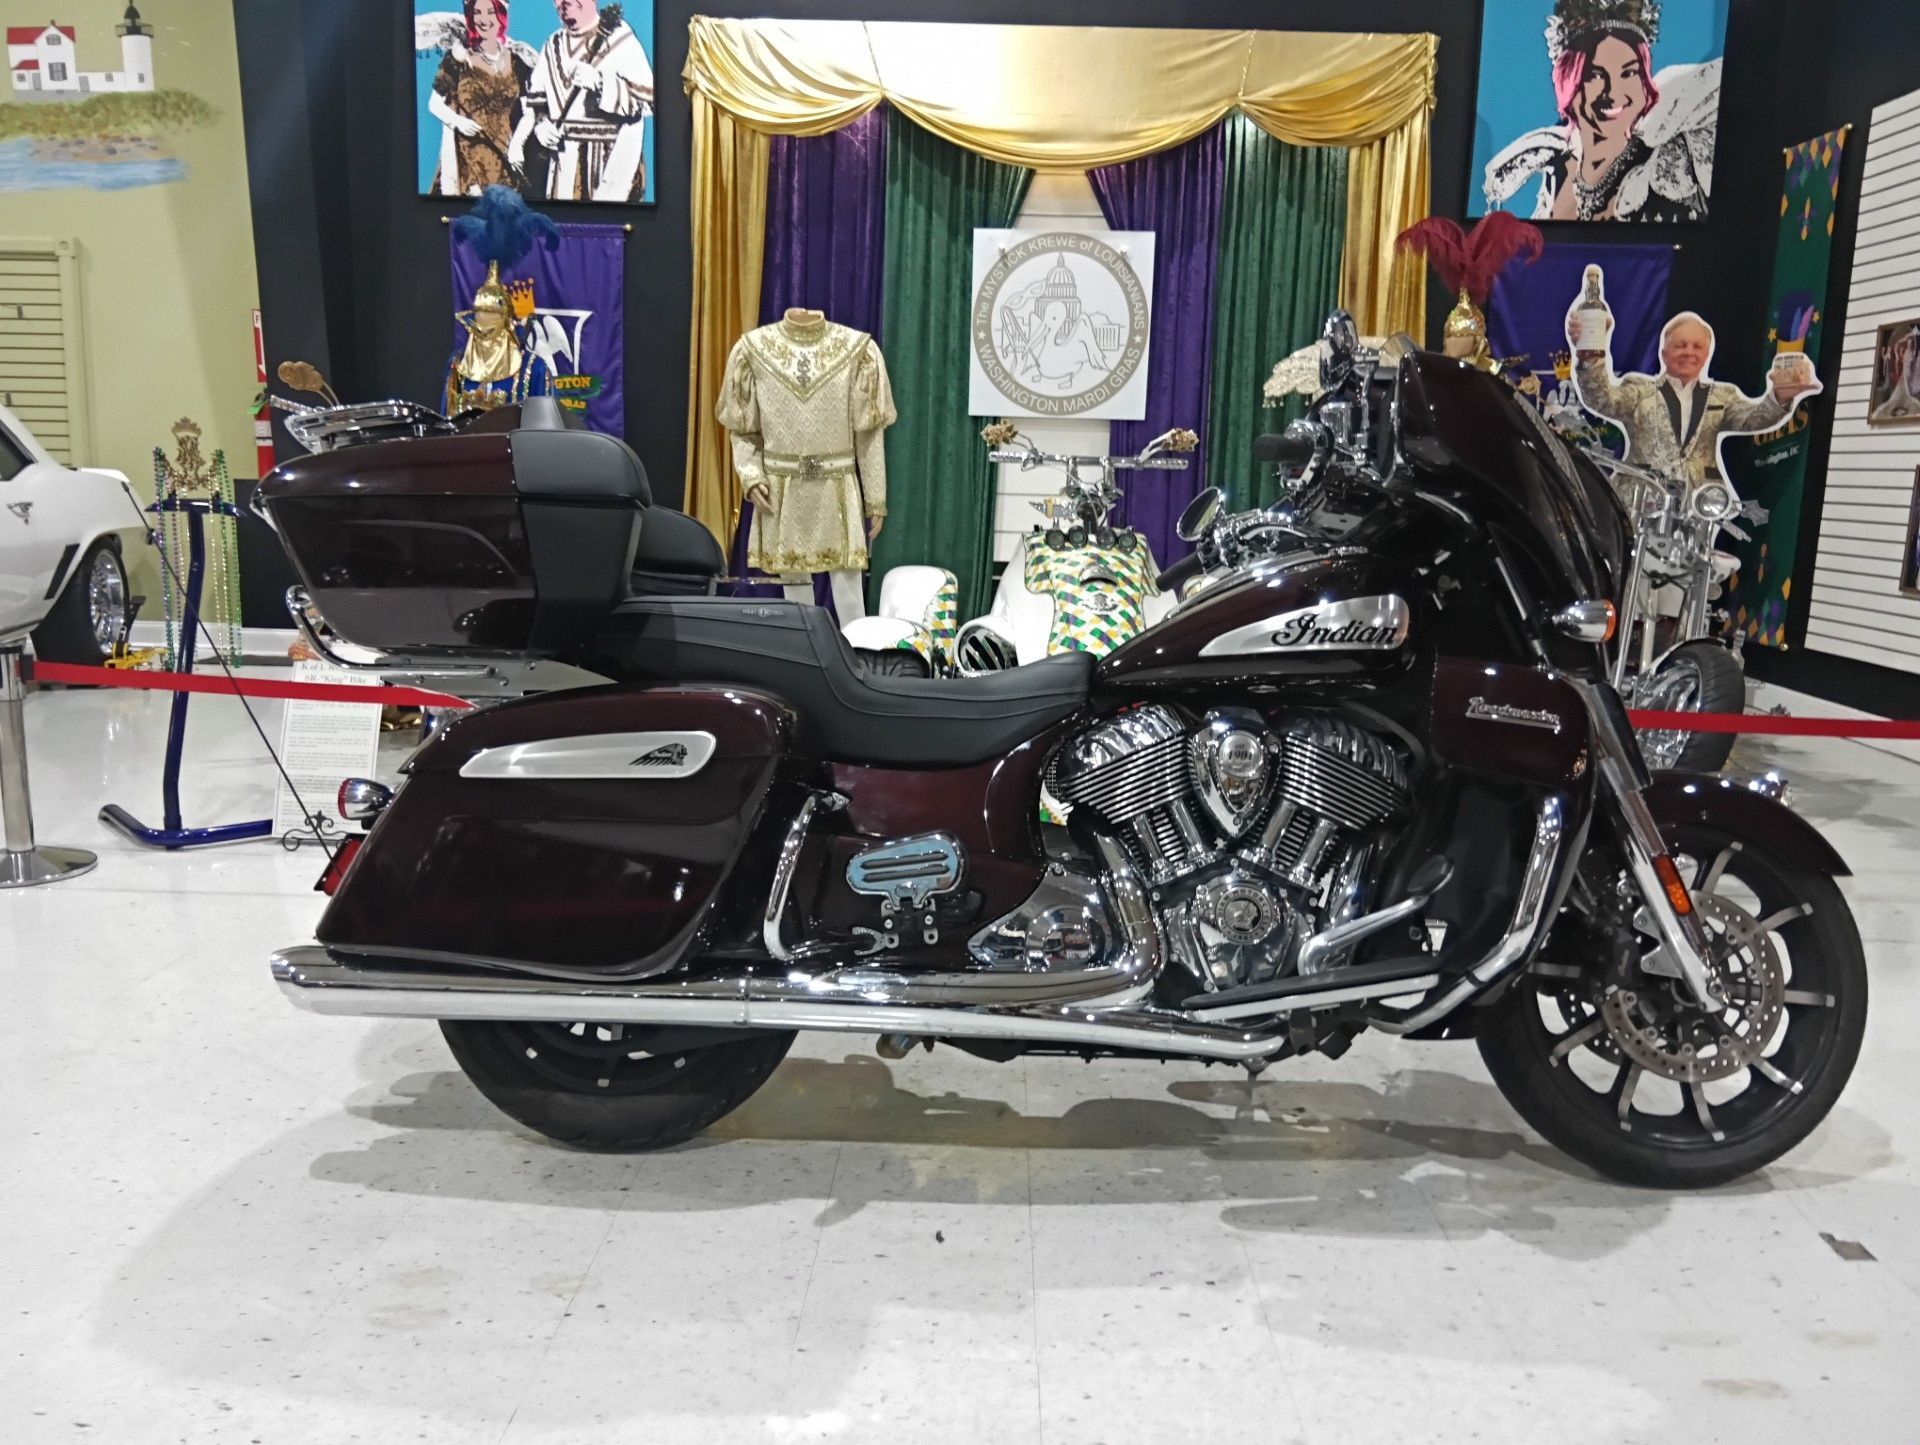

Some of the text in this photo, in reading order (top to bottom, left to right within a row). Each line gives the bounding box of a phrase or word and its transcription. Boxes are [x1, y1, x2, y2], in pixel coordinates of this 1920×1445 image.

[976, 235, 1145, 330] The MYSTICK KREWE of LOUISIANANS
[977, 343, 1141, 412] WASHINGTON MARDI GRAS
[1271, 613, 1398, 646] Indian
[1228, 750, 1253, 760] 1901
